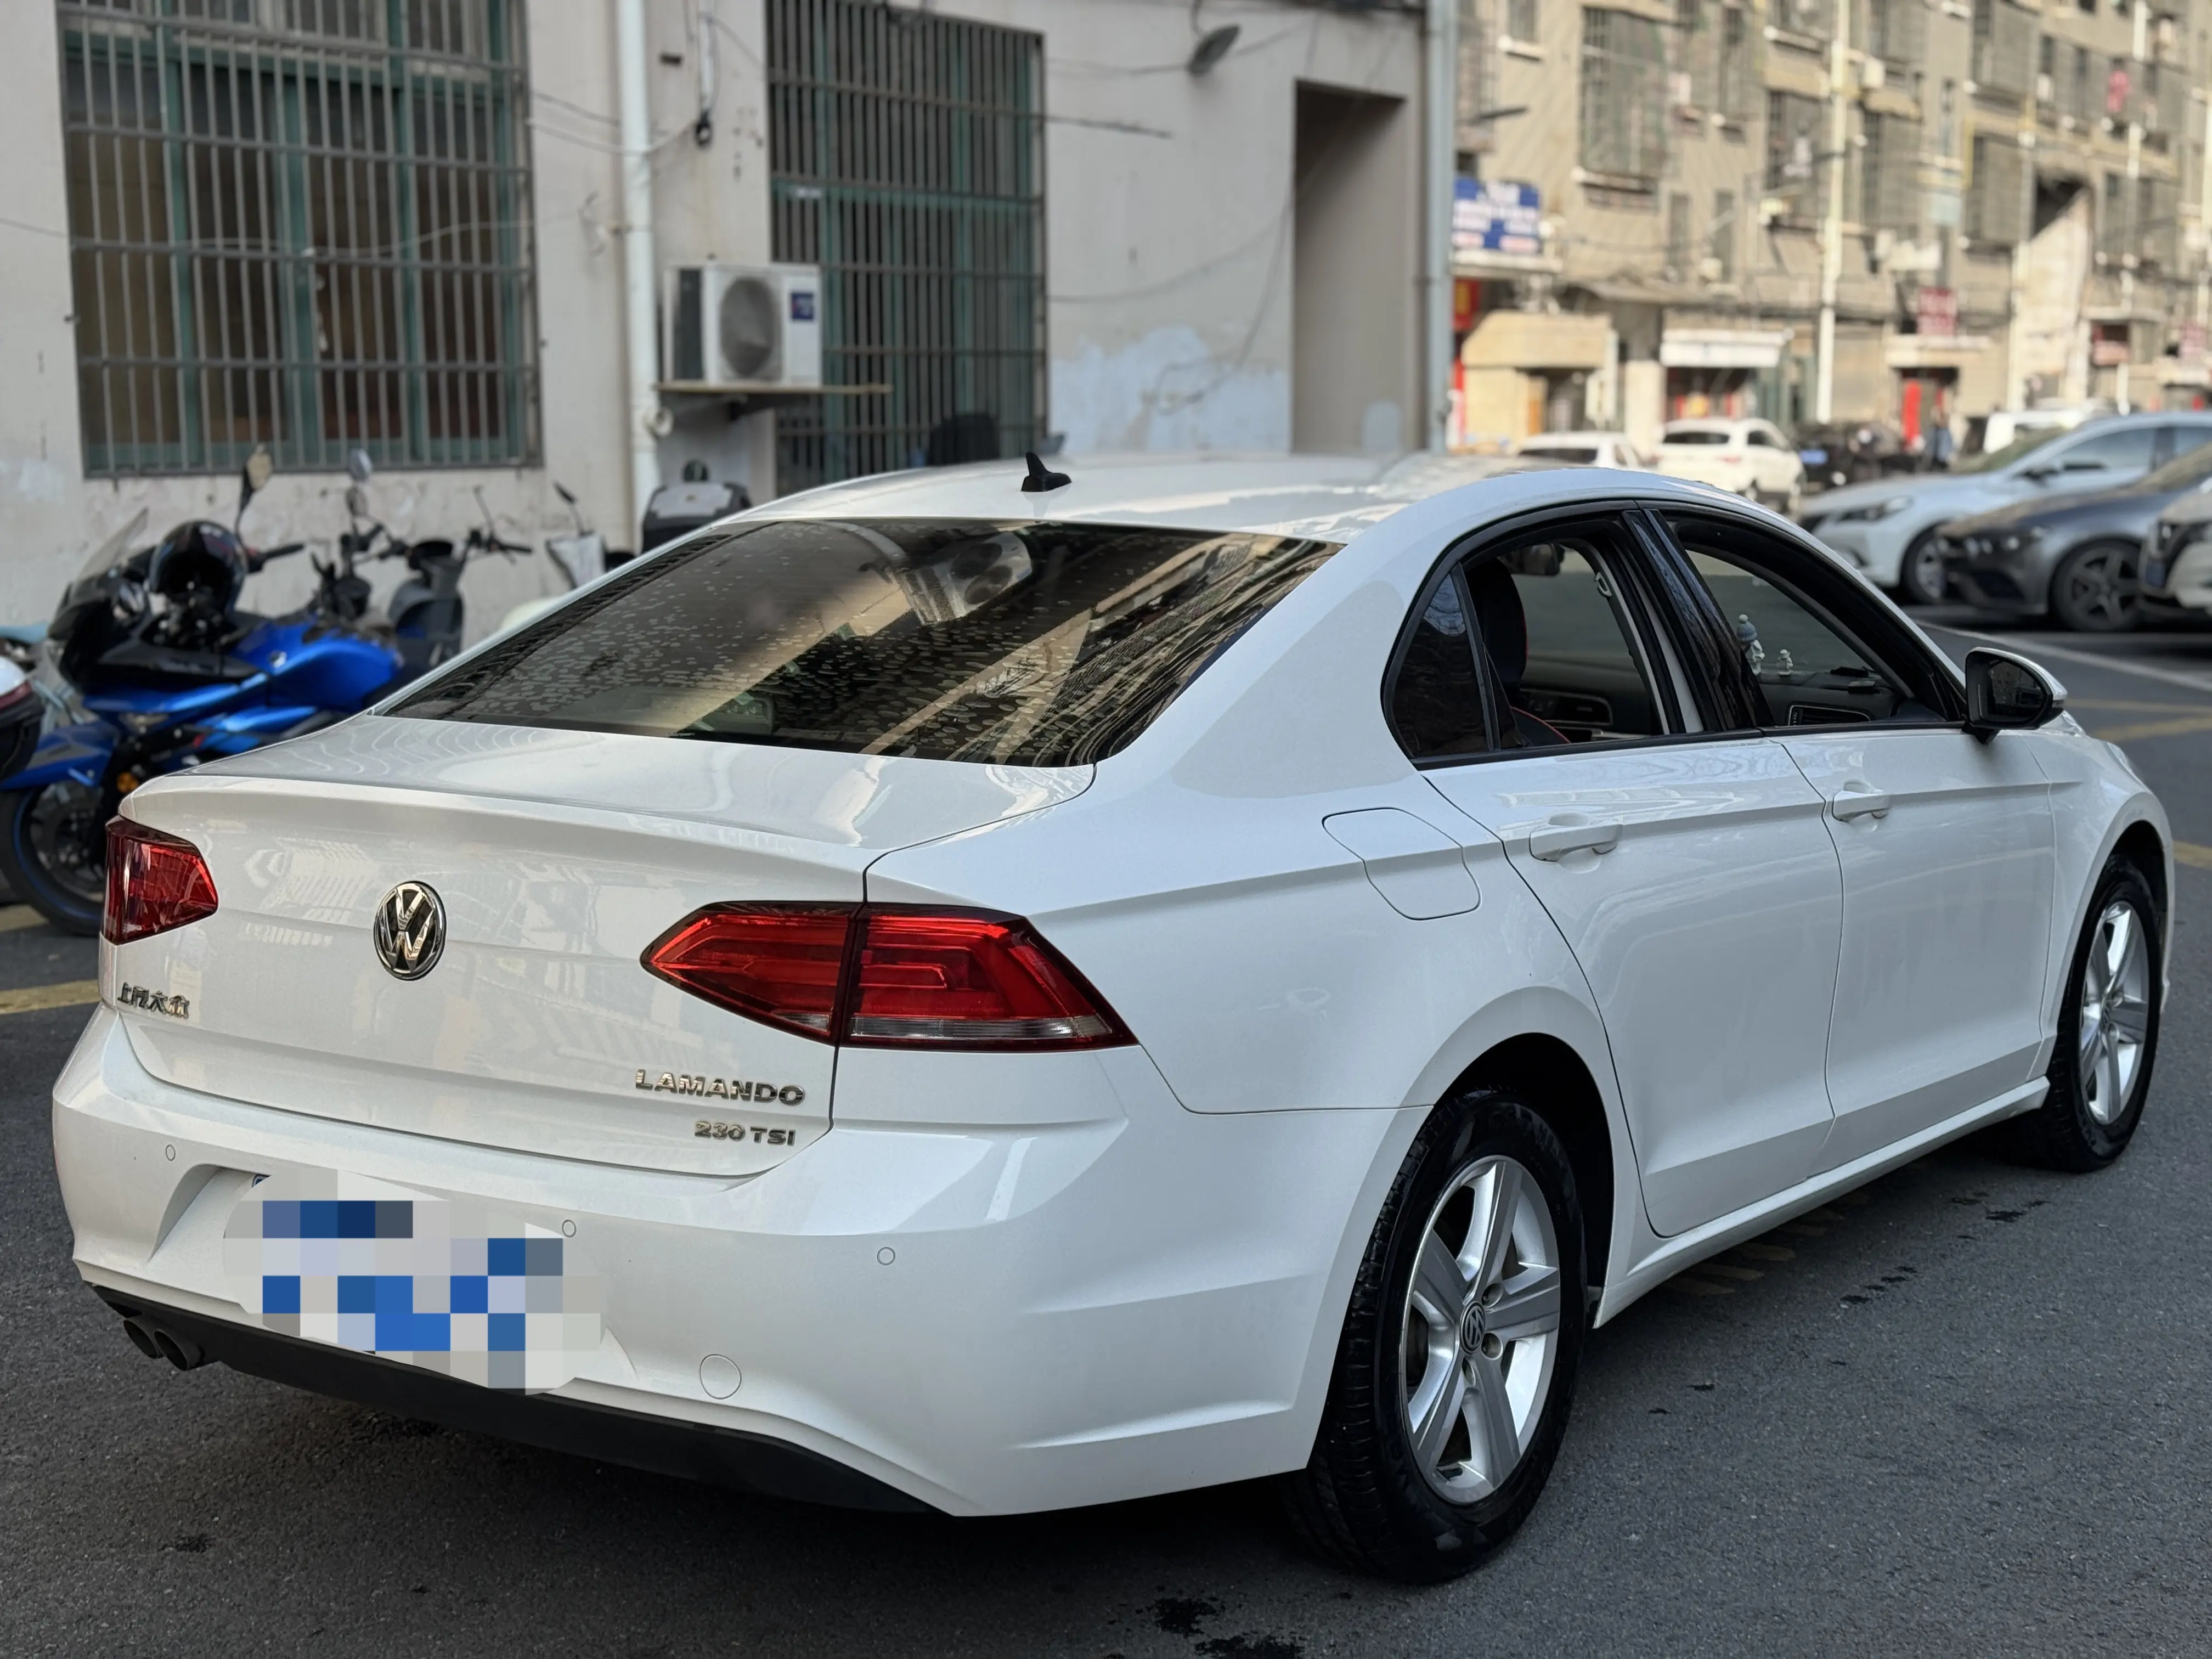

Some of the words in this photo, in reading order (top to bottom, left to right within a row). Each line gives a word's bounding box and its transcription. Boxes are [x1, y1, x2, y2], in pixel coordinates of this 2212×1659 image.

[635, 1069, 805, 1106] LAMANDO
[694, 1120, 746, 1142] 230
[750, 1126, 796, 1147] TSI
